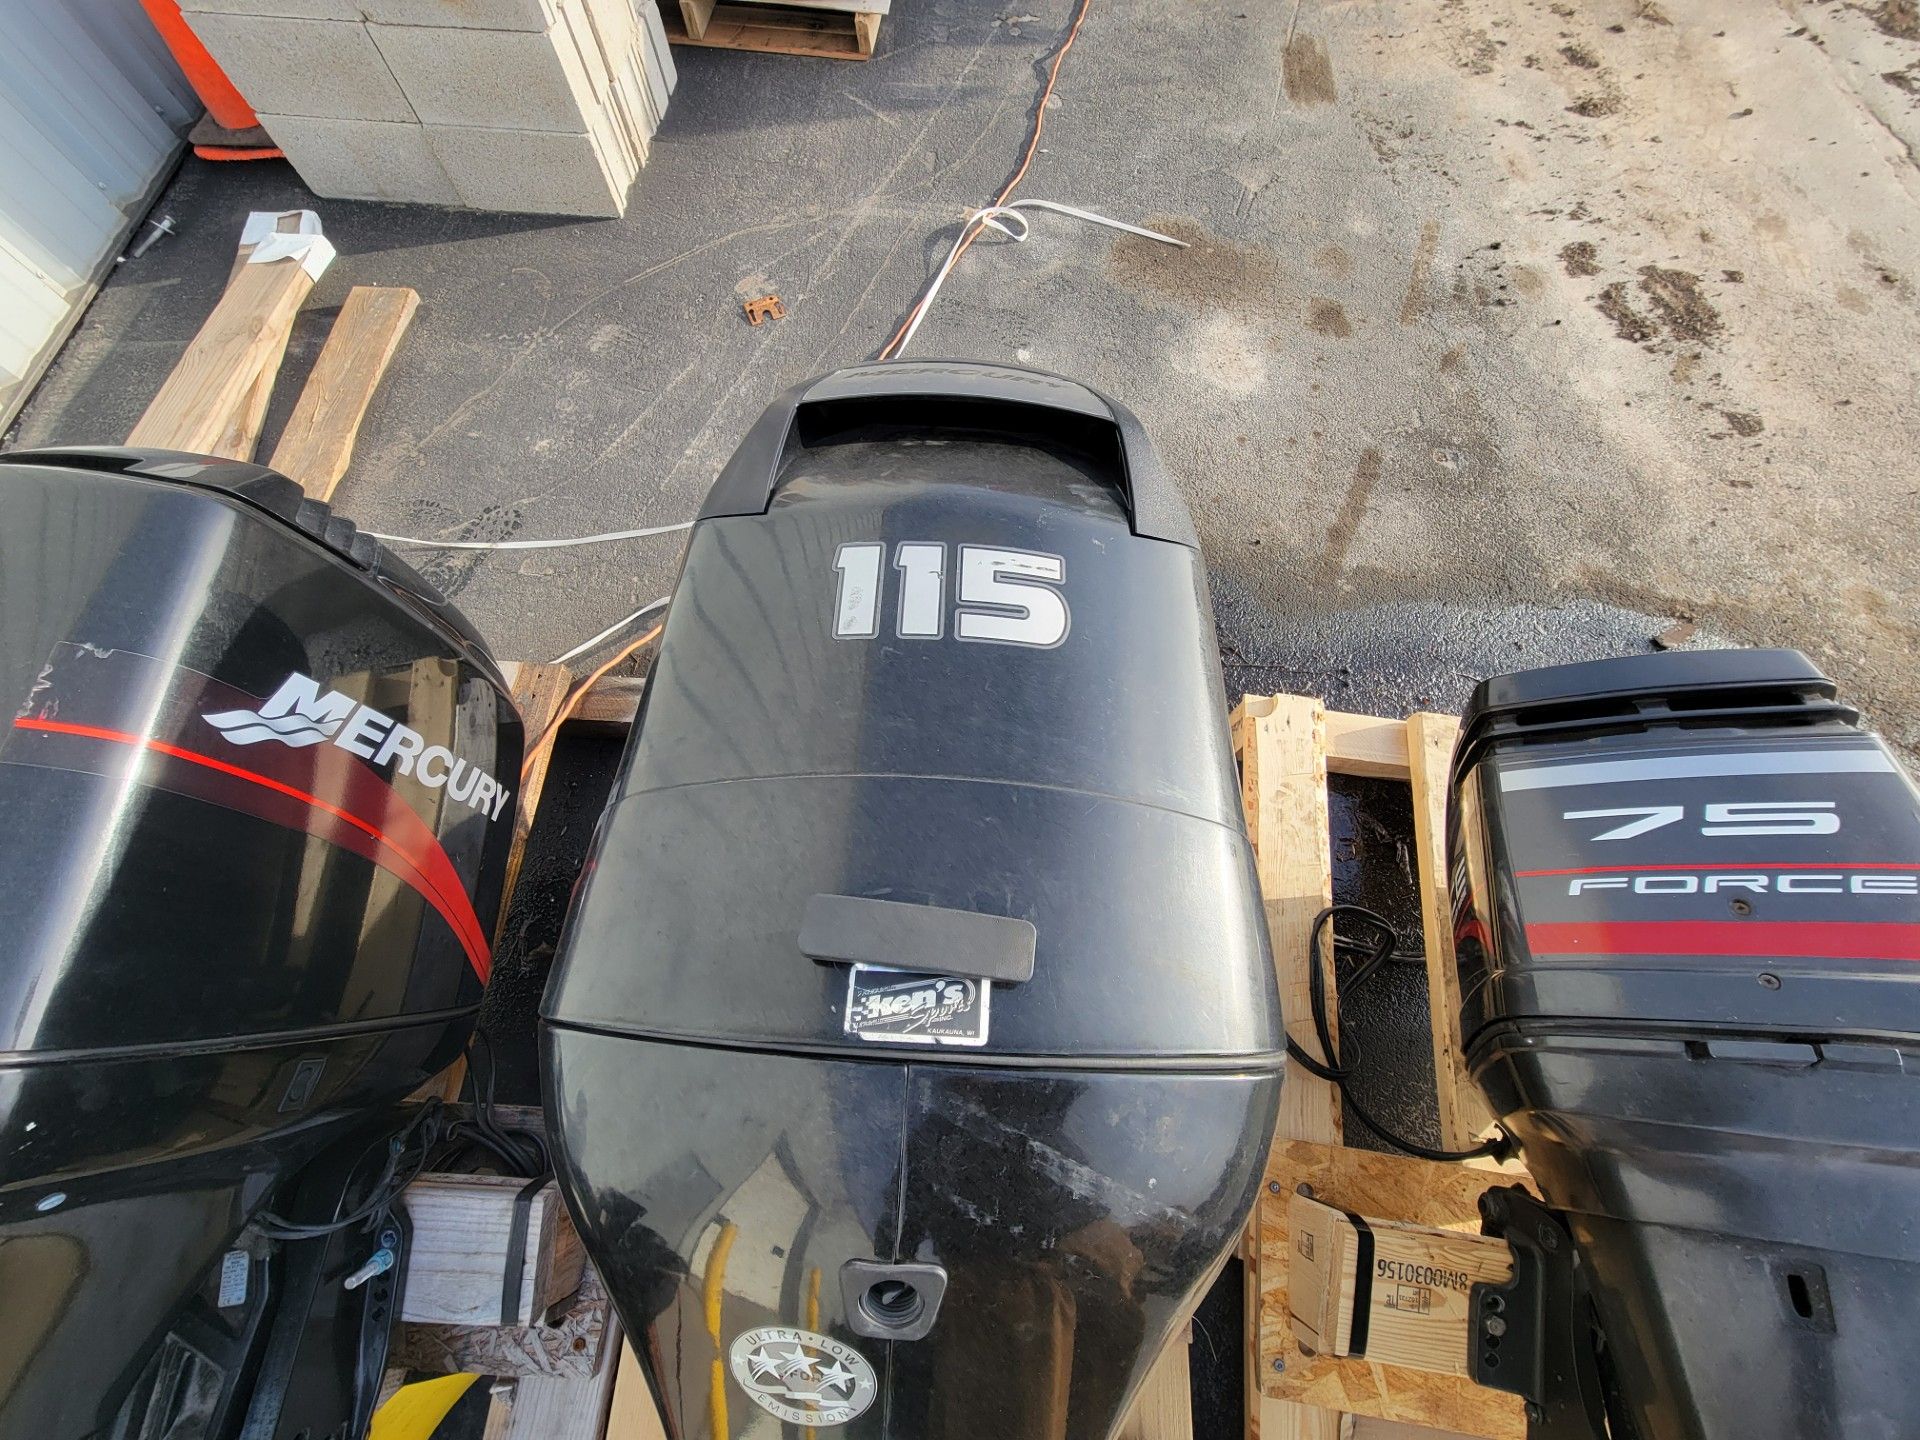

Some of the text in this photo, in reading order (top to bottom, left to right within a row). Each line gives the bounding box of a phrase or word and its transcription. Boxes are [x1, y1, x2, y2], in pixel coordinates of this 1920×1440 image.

[832, 541, 1071, 650] 115
[256, 671, 510, 823] MERCURY
[1563, 801, 1840, 841] 75
[1568, 874, 1918, 897] FORCE
[1377, 1259, 1468, 1291] 8M0030156
[745, 1329, 860, 1365] ULTRA LOW
[757, 1393, 850, 1423] EMISSION
